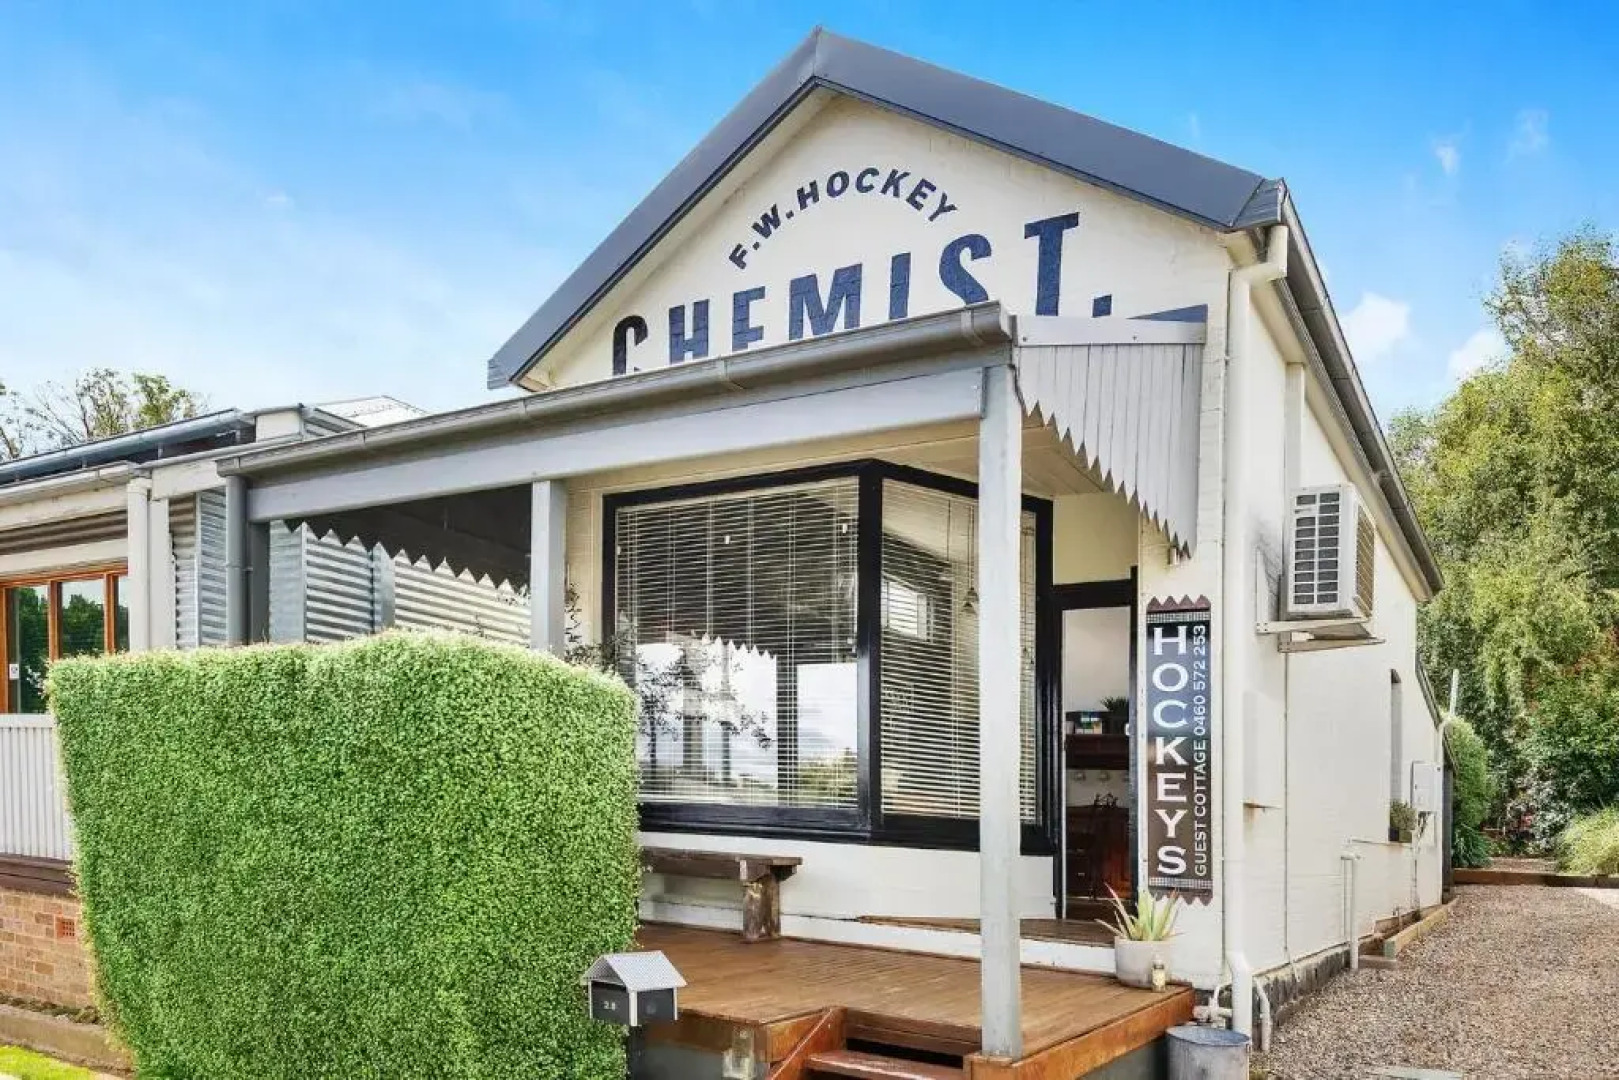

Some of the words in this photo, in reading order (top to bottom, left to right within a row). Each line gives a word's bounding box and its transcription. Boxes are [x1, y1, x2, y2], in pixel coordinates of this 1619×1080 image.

[1193, 624, 1206, 656] 253
[1193, 659, 1206, 692] 572
[1193, 695, 1206, 736] 0460
[1152, 625, 1189, 876] HOCKEYS
[1194, 739, 1207, 817] COTTAGE
[1194, 820, 1207, 876] GUEST
